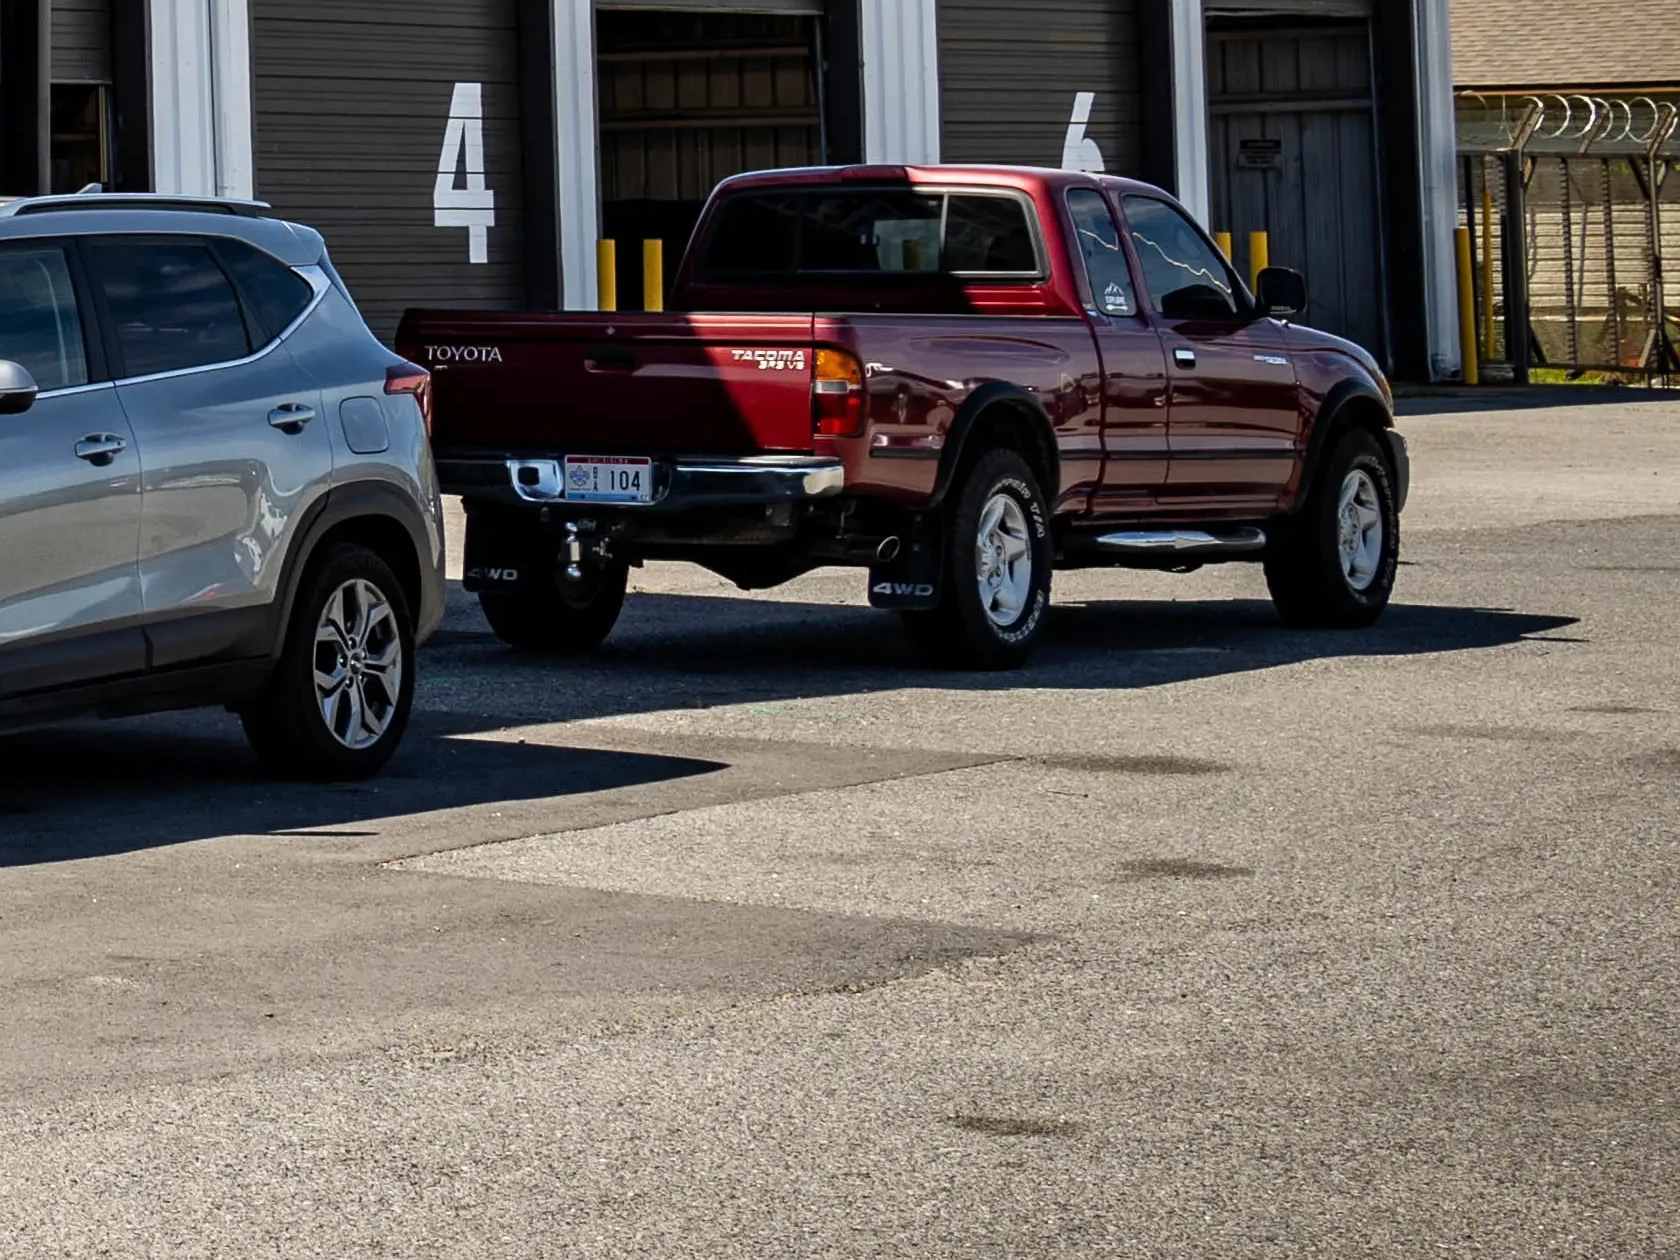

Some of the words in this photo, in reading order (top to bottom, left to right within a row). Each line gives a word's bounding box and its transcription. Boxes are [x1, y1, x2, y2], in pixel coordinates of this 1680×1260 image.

[433, 83, 495, 264] 4
[425, 345, 502, 362] TOYOTA
[731, 349, 804, 361] TACOMA
[610, 470, 640, 491] 104
[467, 567, 518, 581] 4WD
[873, 582, 933, 596] 4WD
